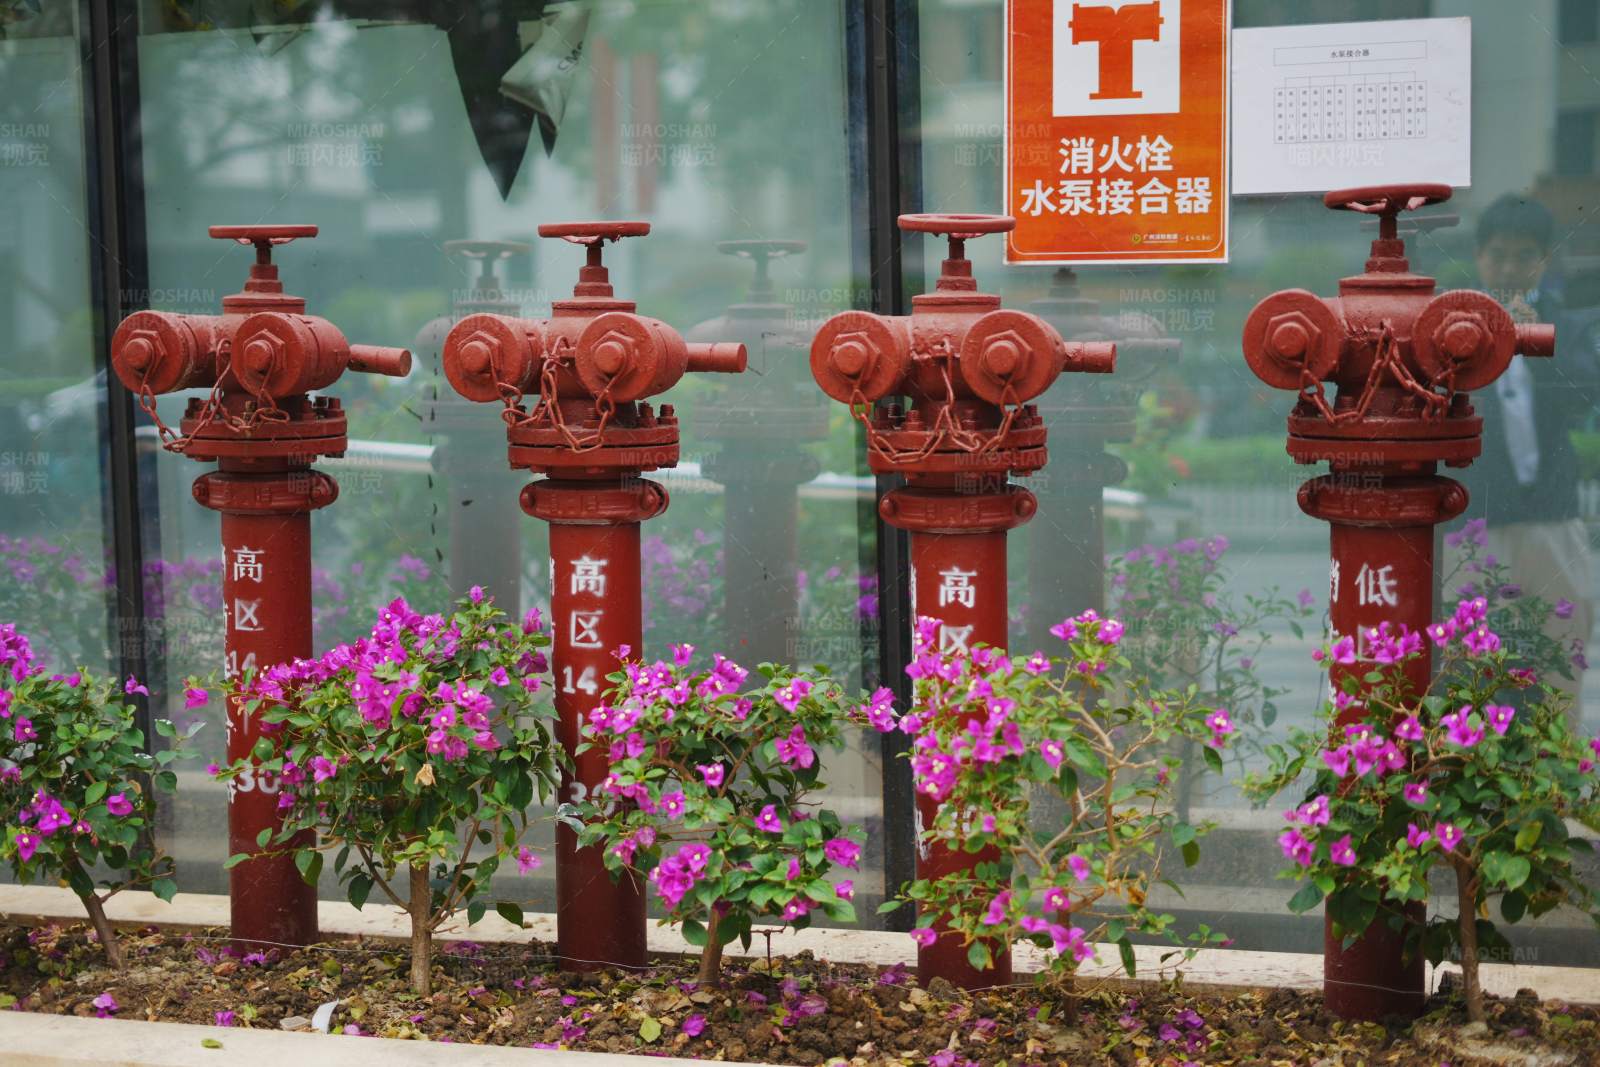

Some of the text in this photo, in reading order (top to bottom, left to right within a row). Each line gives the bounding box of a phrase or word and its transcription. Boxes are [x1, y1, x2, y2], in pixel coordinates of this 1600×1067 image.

[1058, 135, 1173, 174] 消火栓
[1020, 177, 1212, 217] 水泵接合器
[232, 546, 264, 631] 高区
[570, 556, 609, 649] 高区
[939, 566, 977, 656] 高区
[562, 666, 599, 696] 14
